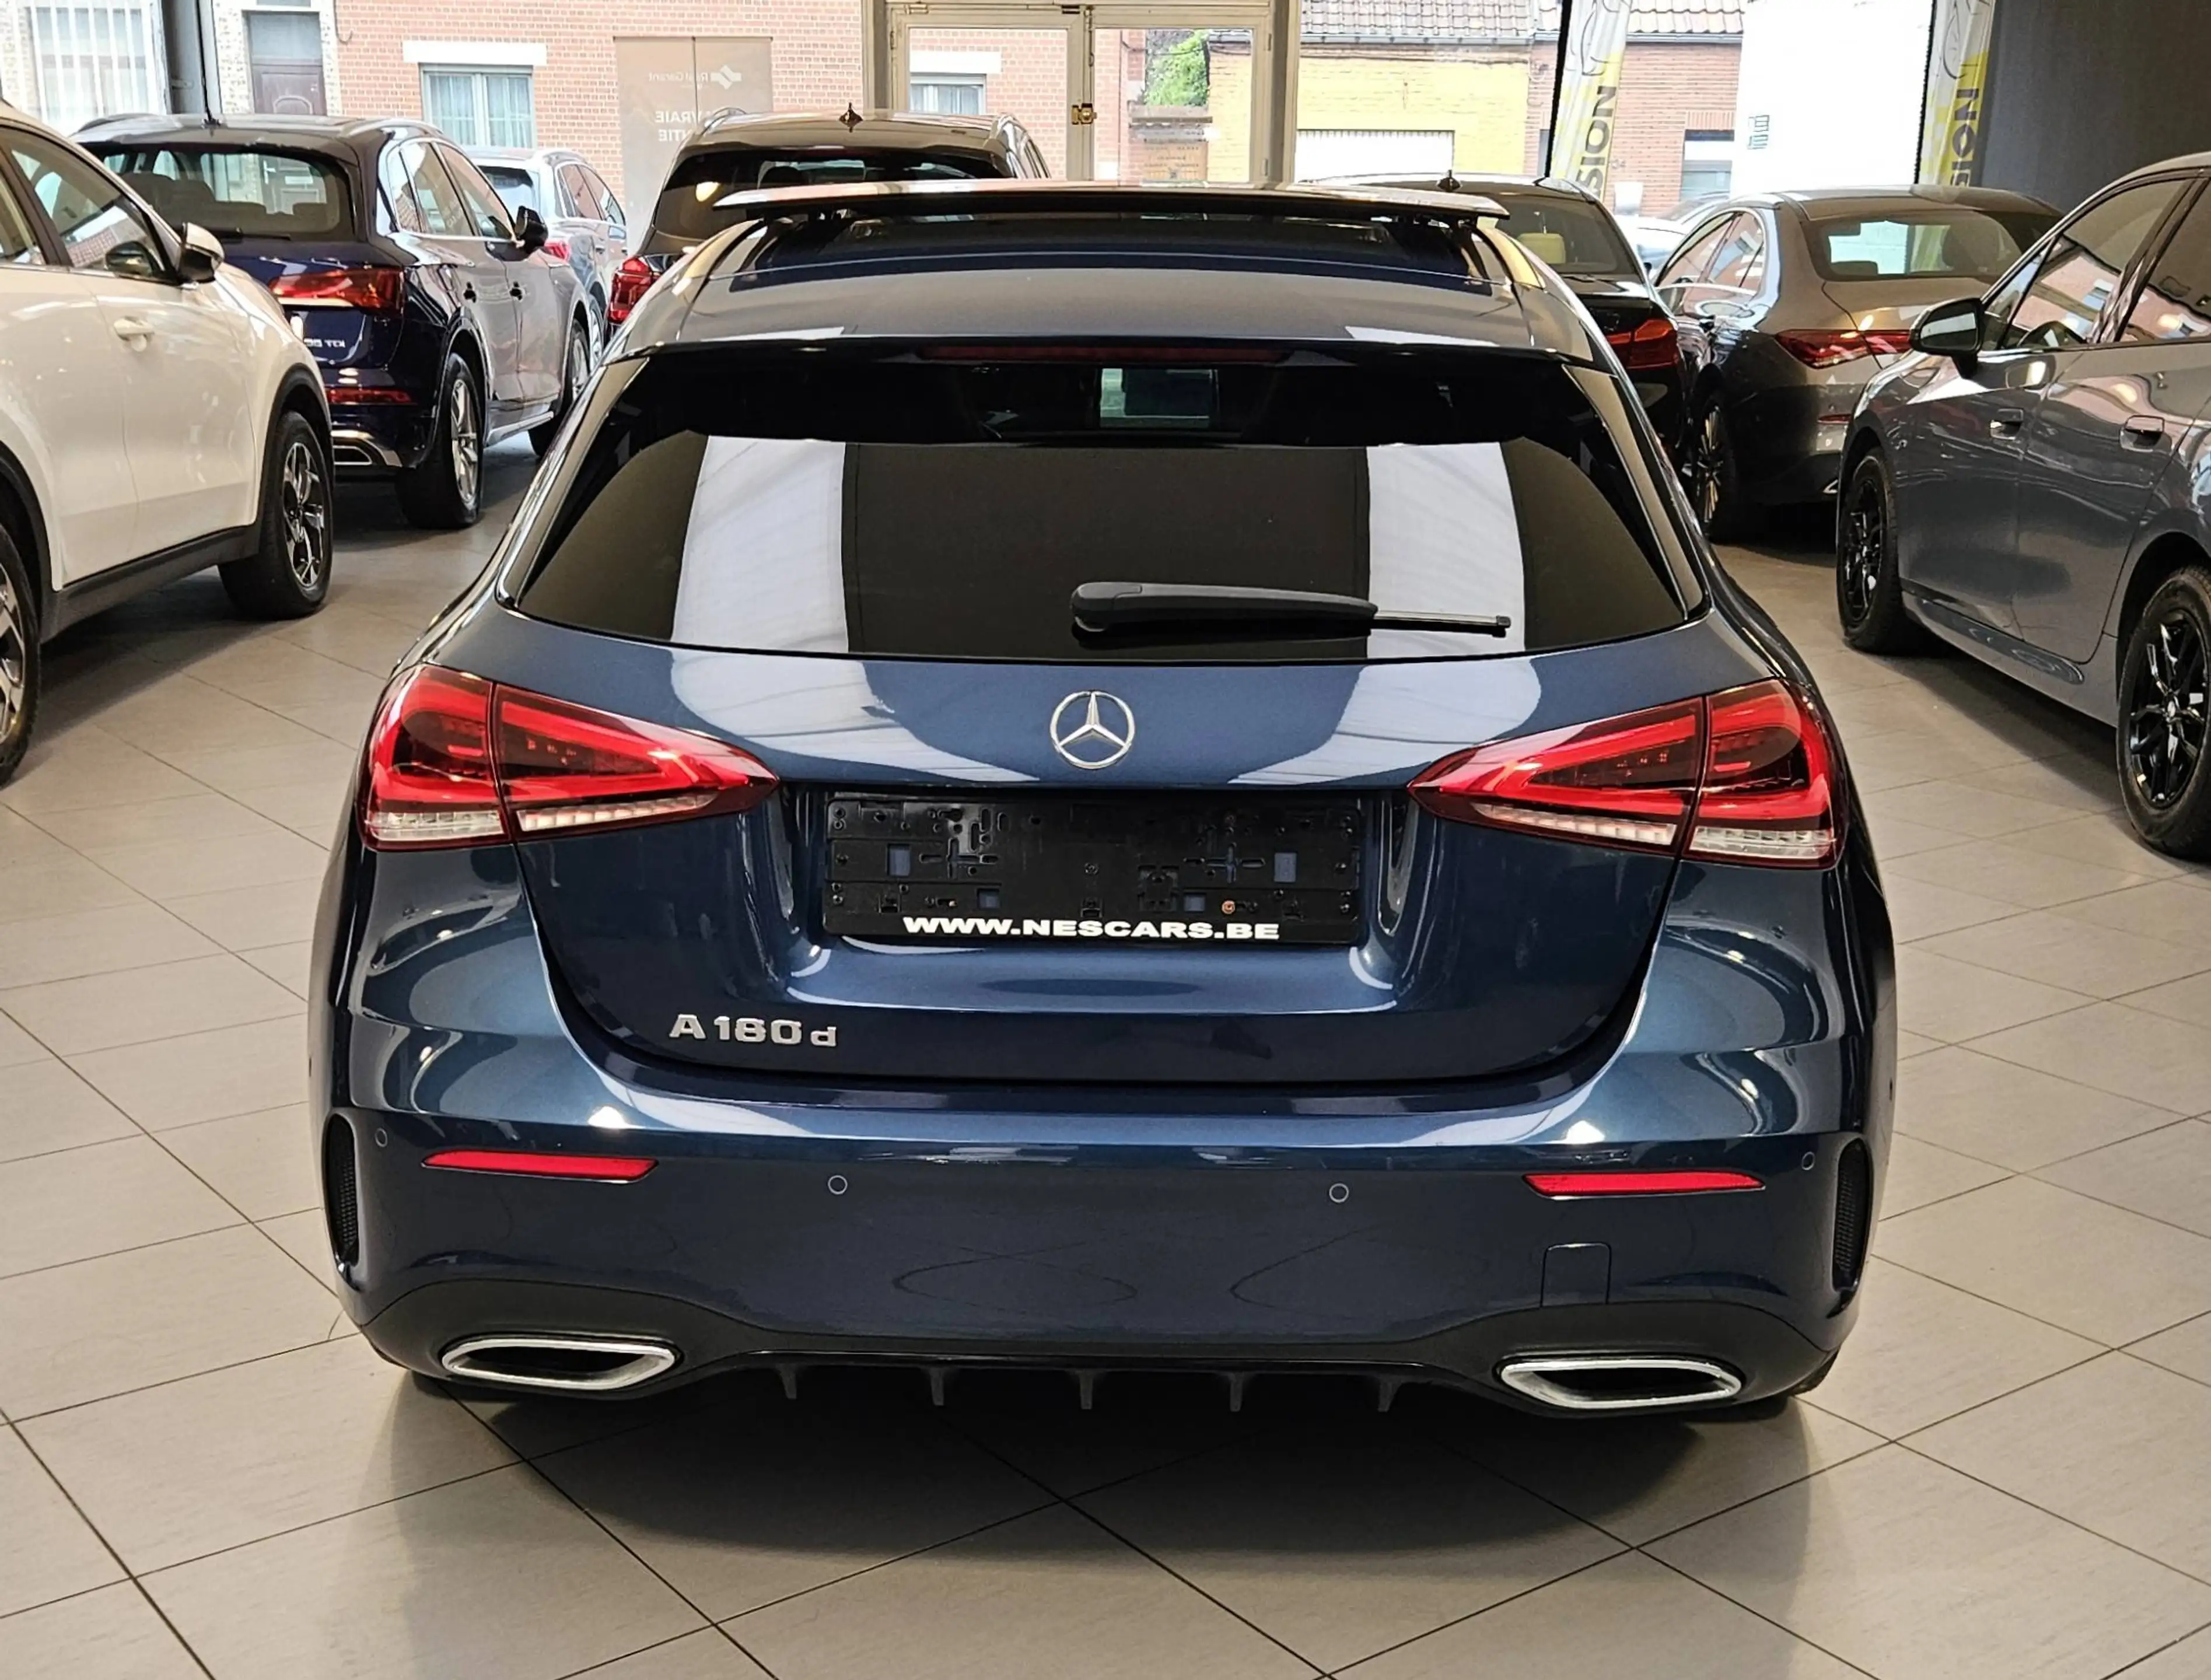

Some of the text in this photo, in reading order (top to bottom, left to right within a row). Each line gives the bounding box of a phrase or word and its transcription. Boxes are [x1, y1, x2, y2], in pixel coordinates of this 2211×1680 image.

[902, 916, 1280, 940] WWW.NESCARS.BE
[669, 1013, 707, 1040] A
[809, 1026, 838, 1047] d
